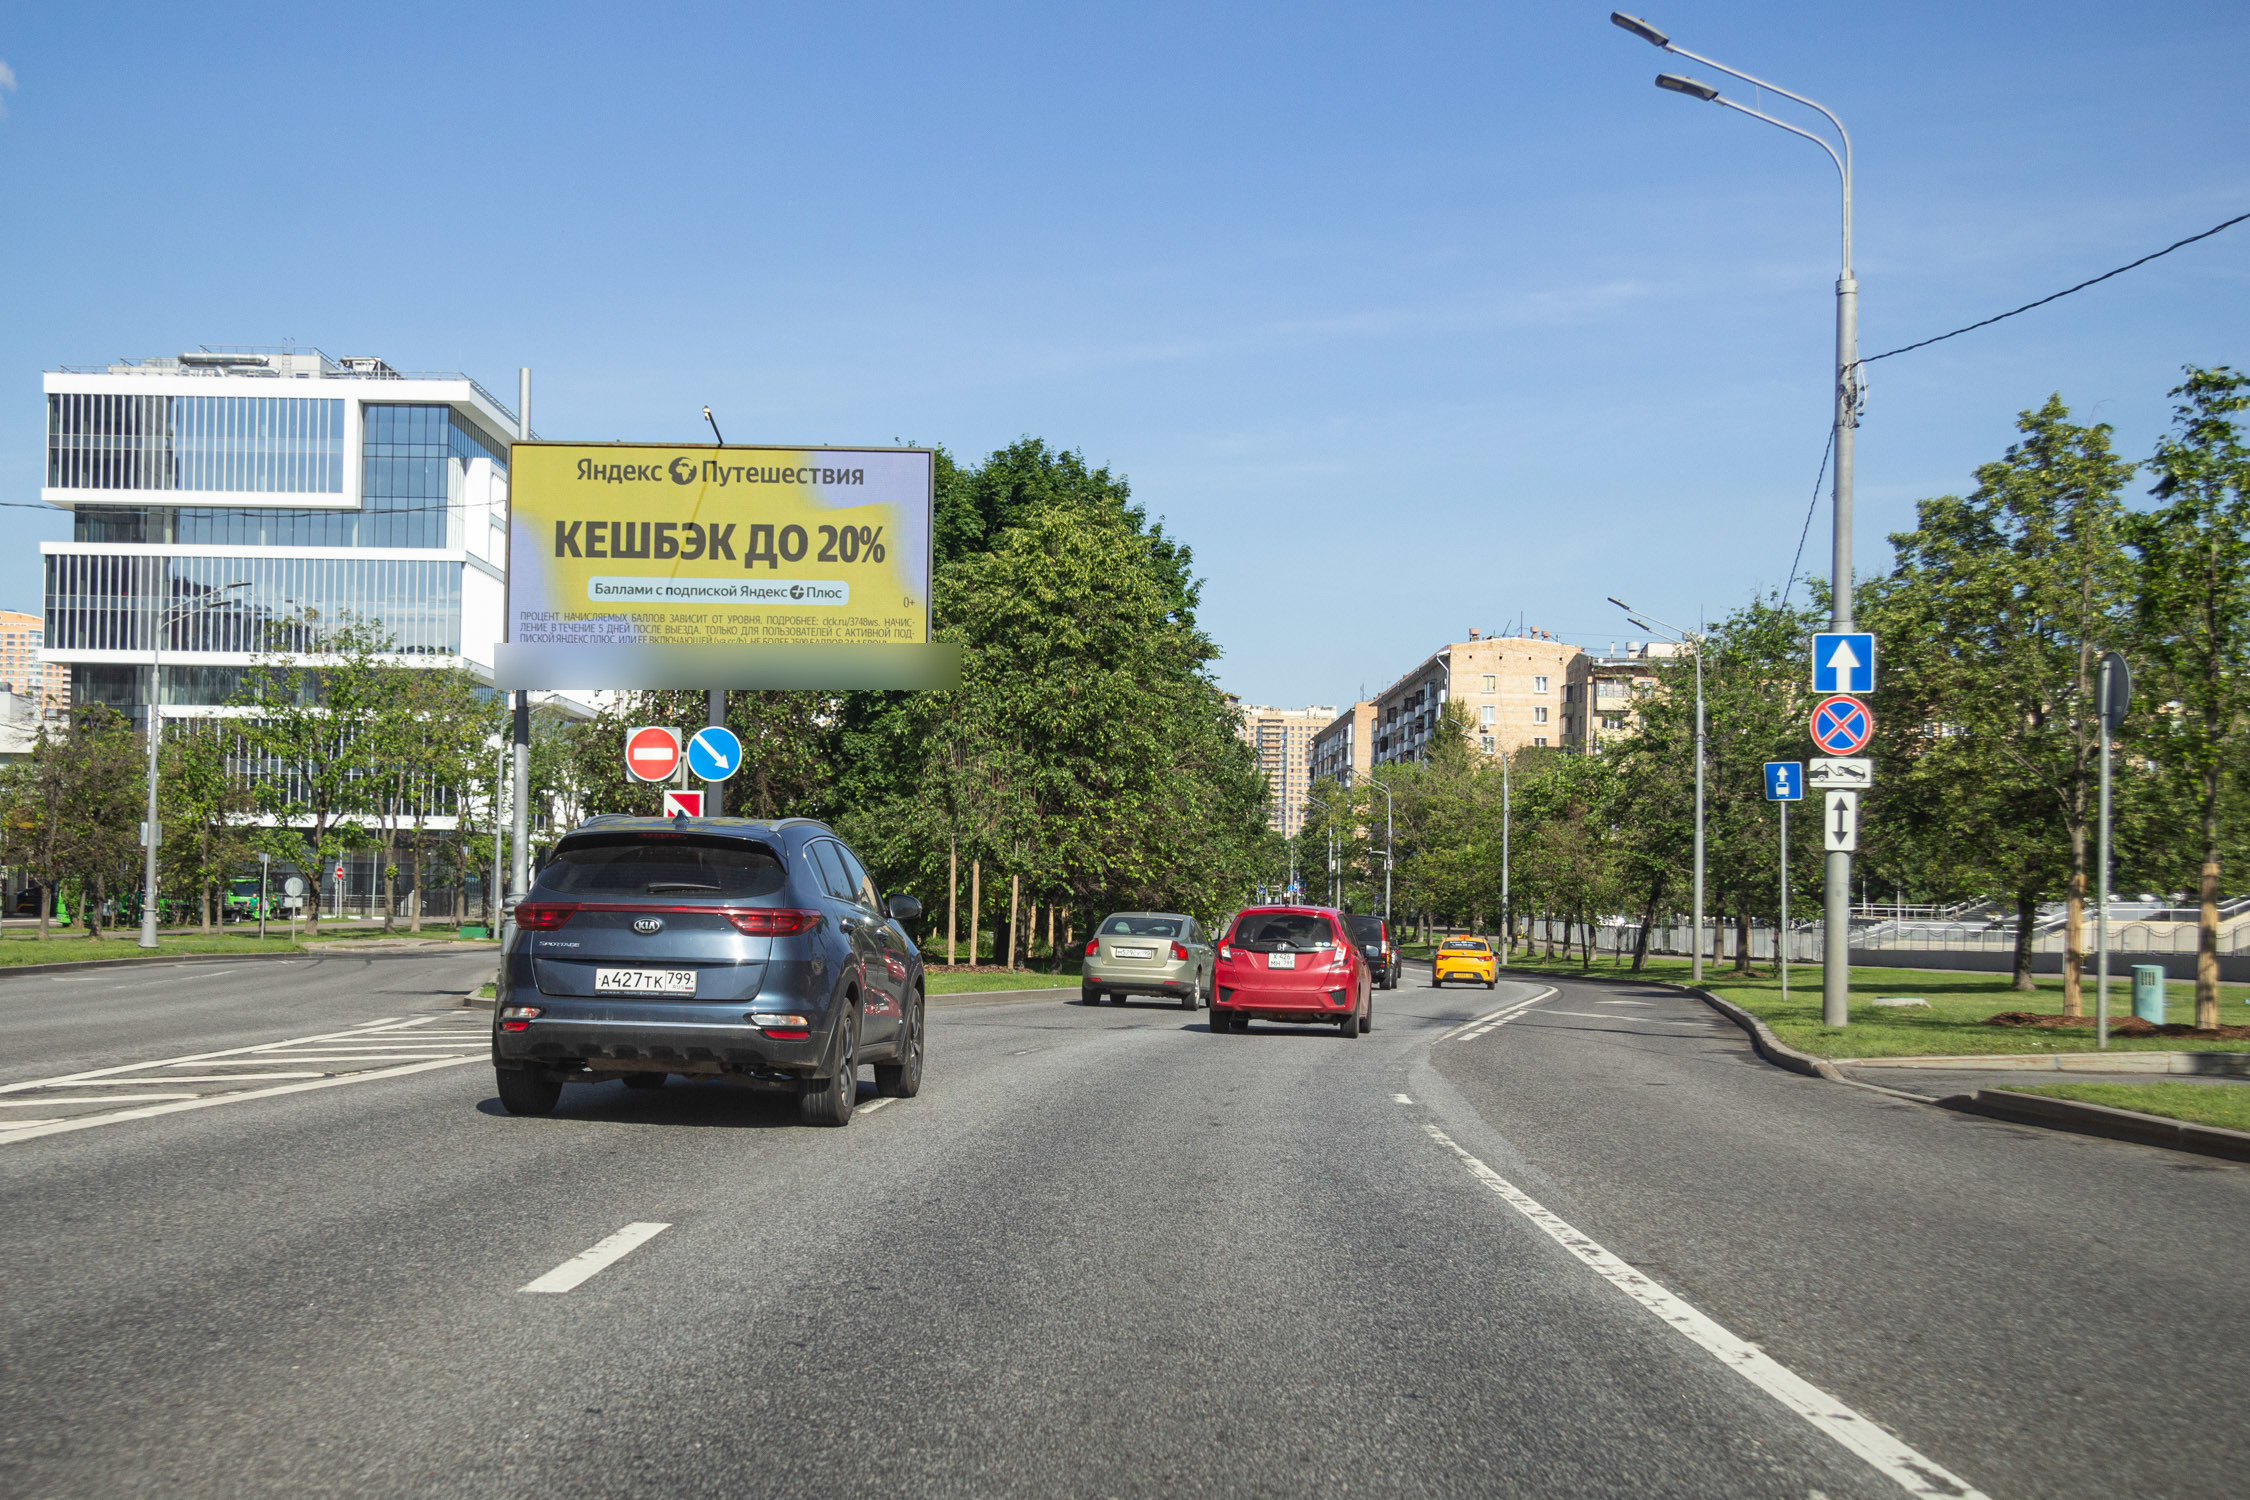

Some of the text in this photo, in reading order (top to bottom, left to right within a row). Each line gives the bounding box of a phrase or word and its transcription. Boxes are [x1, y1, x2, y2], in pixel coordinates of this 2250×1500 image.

[577, 458, 864, 487] Яндекс Путешествия
[555, 520, 886, 569] КЕШБЭК ДО 20%
[595, 583, 842, 599] Баллами с подпиской Яндекс Плюс
[903, 597, 916, 608] 0+
[520, 612, 560, 622] ПРОЦЕНТ
[564, 613, 627, 622] НАЧИСЛЯЕМЫХ
[631, 614, 665, 623] БАЛЛОВ
[669, 614, 708, 623] ЗАВИСИТ
[712, 615, 723, 624] ОТ
[767, 616, 819, 626] ПОДРОБНЕЕ:
[884, 618, 916, 627] НАЧИС-
[520, 623, 915, 639] ЛЕНИЕ В ТЕЧЕНИЕ 5 ДНЕЙ ПОСЛЕ ВЫЕЗДА. ТОЛЬКО ДЛЯ ПОЛЬЗОВАТЕЛЕЙ С АКТИВНОЙ ПОД-
[520, 632, 554, 643] ПИСКОЙ
[556, 634, 589, 644] ЯНДЕКС
[619, 635, 637, 644] ИЛИ
[638, 921, 656, 930] KIA
[601, 972, 691, 989] А427ТК 799
